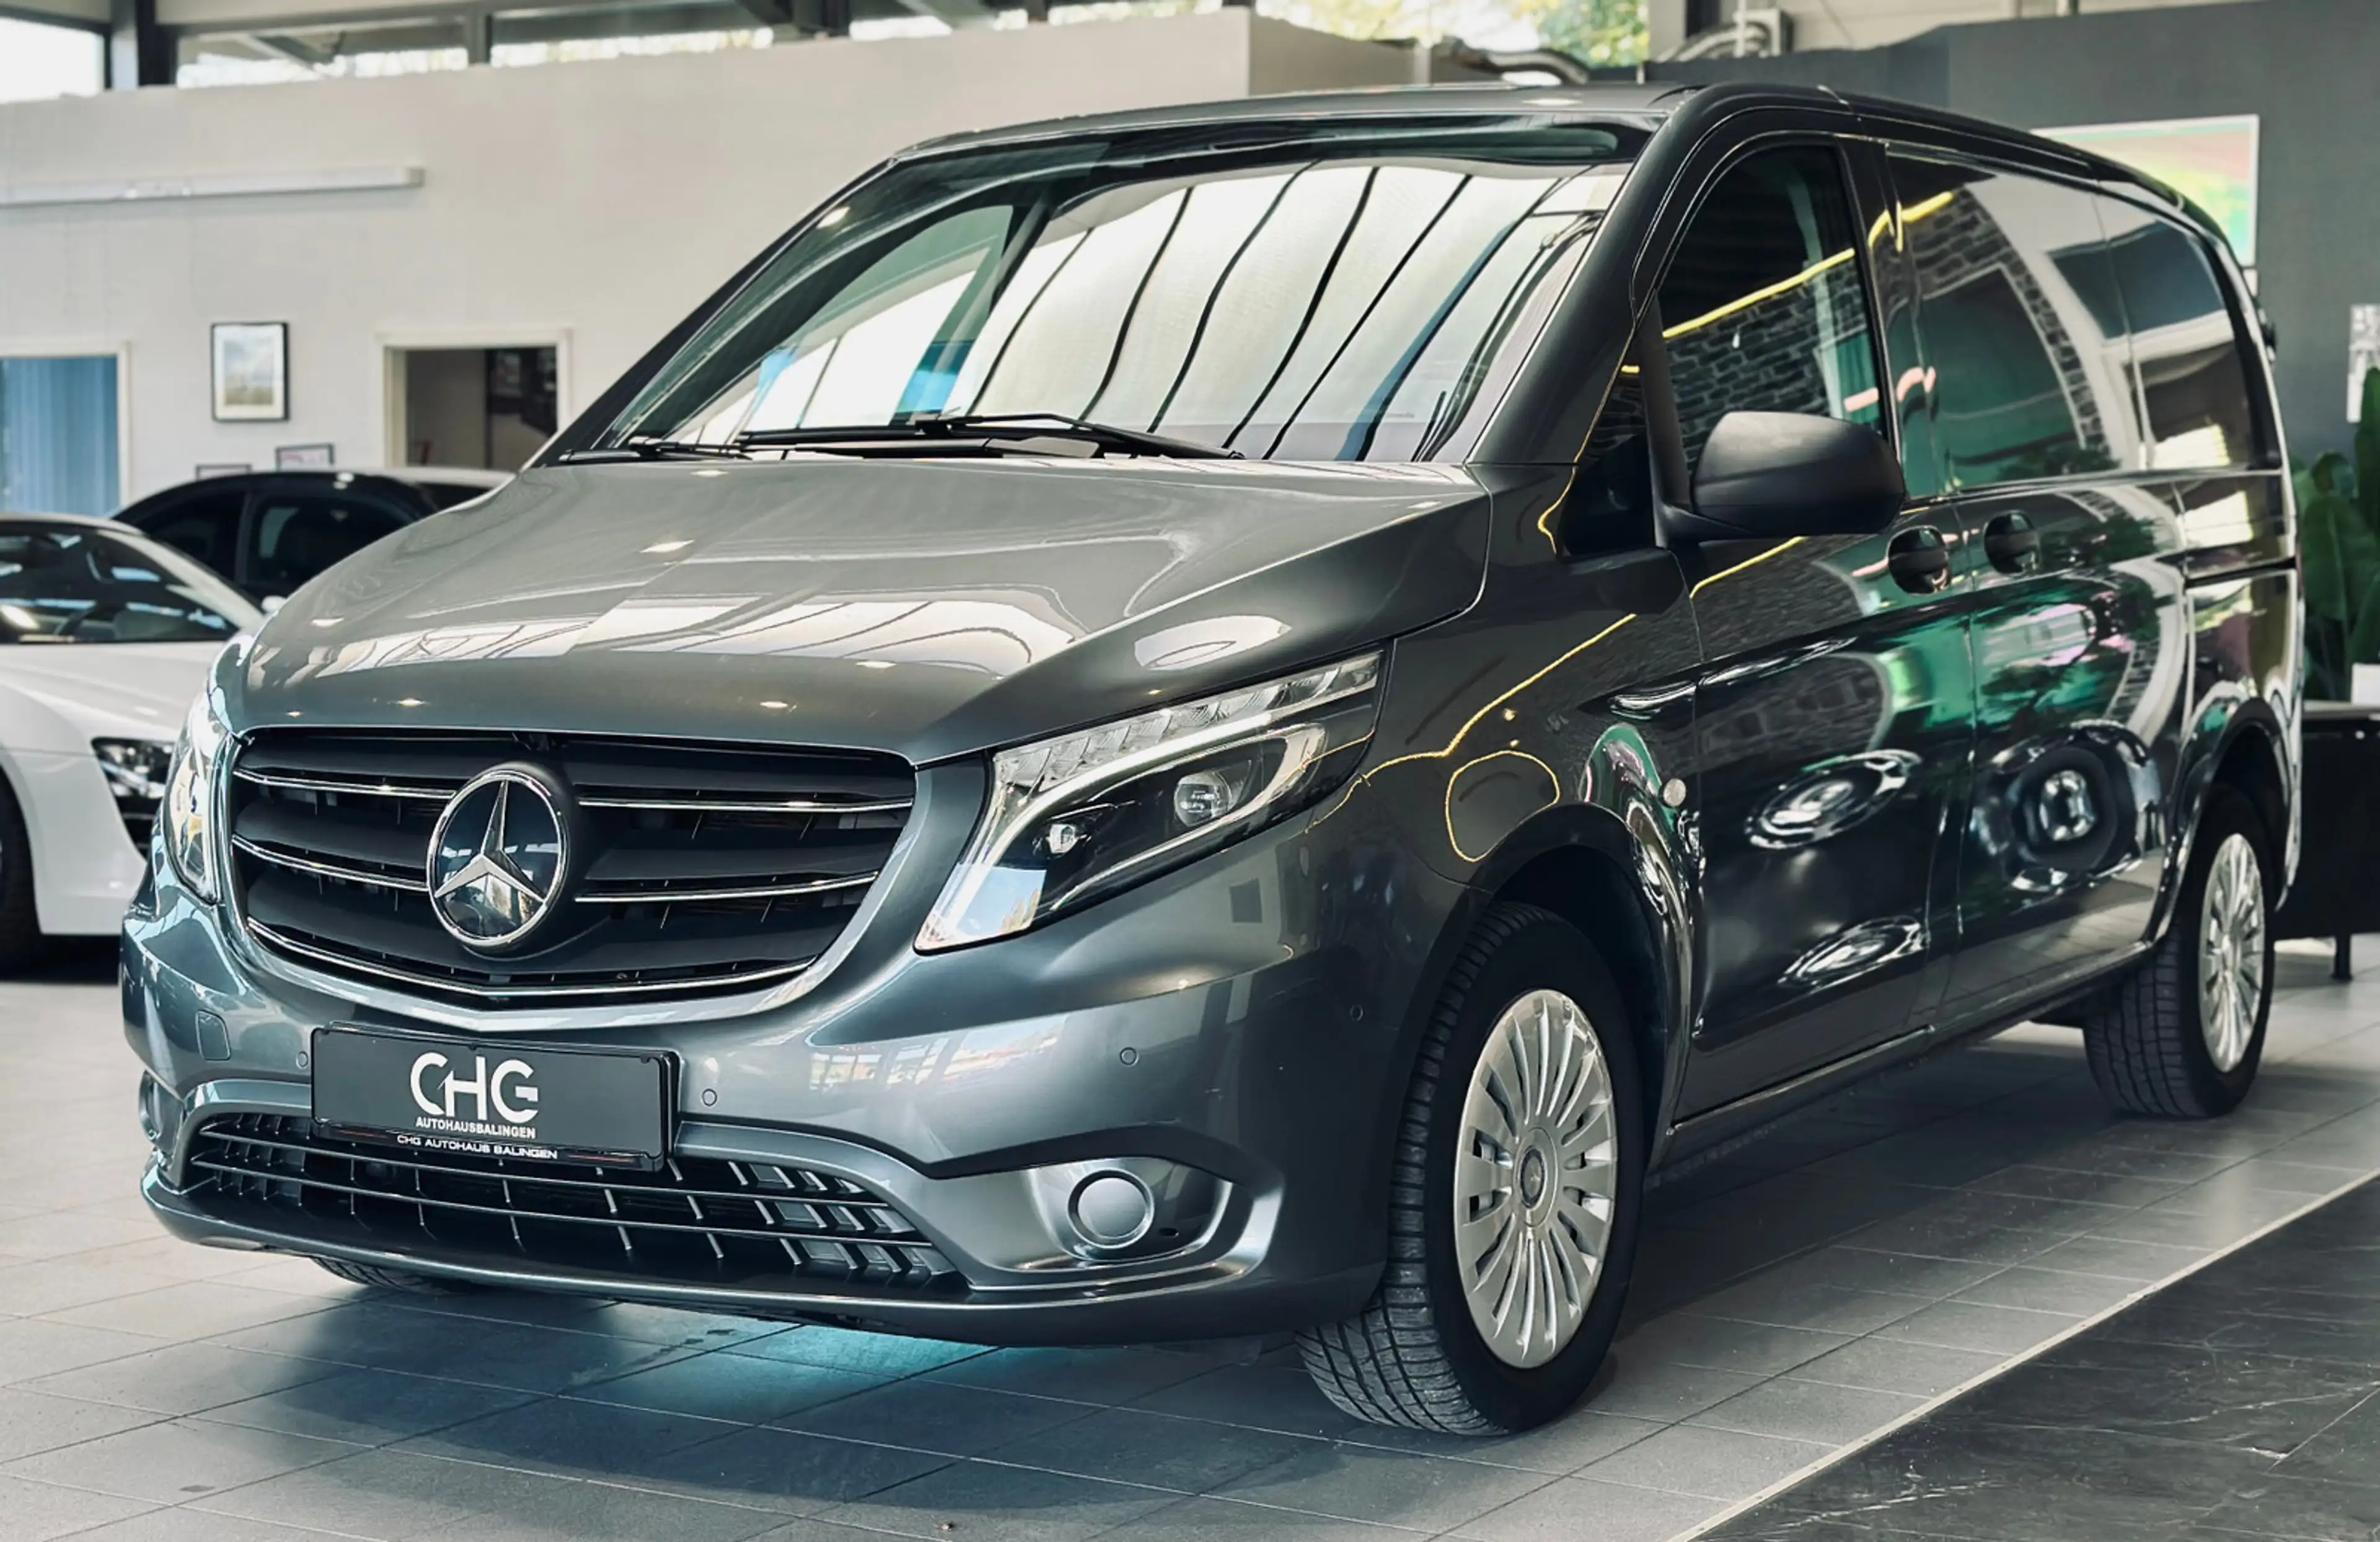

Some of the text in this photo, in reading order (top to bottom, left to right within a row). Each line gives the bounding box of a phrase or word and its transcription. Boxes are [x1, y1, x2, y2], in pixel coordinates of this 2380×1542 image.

[410, 1052, 538, 1124] CHG
[397, 1135, 557, 1159] CHG AUTOHAUS BALINGEN
